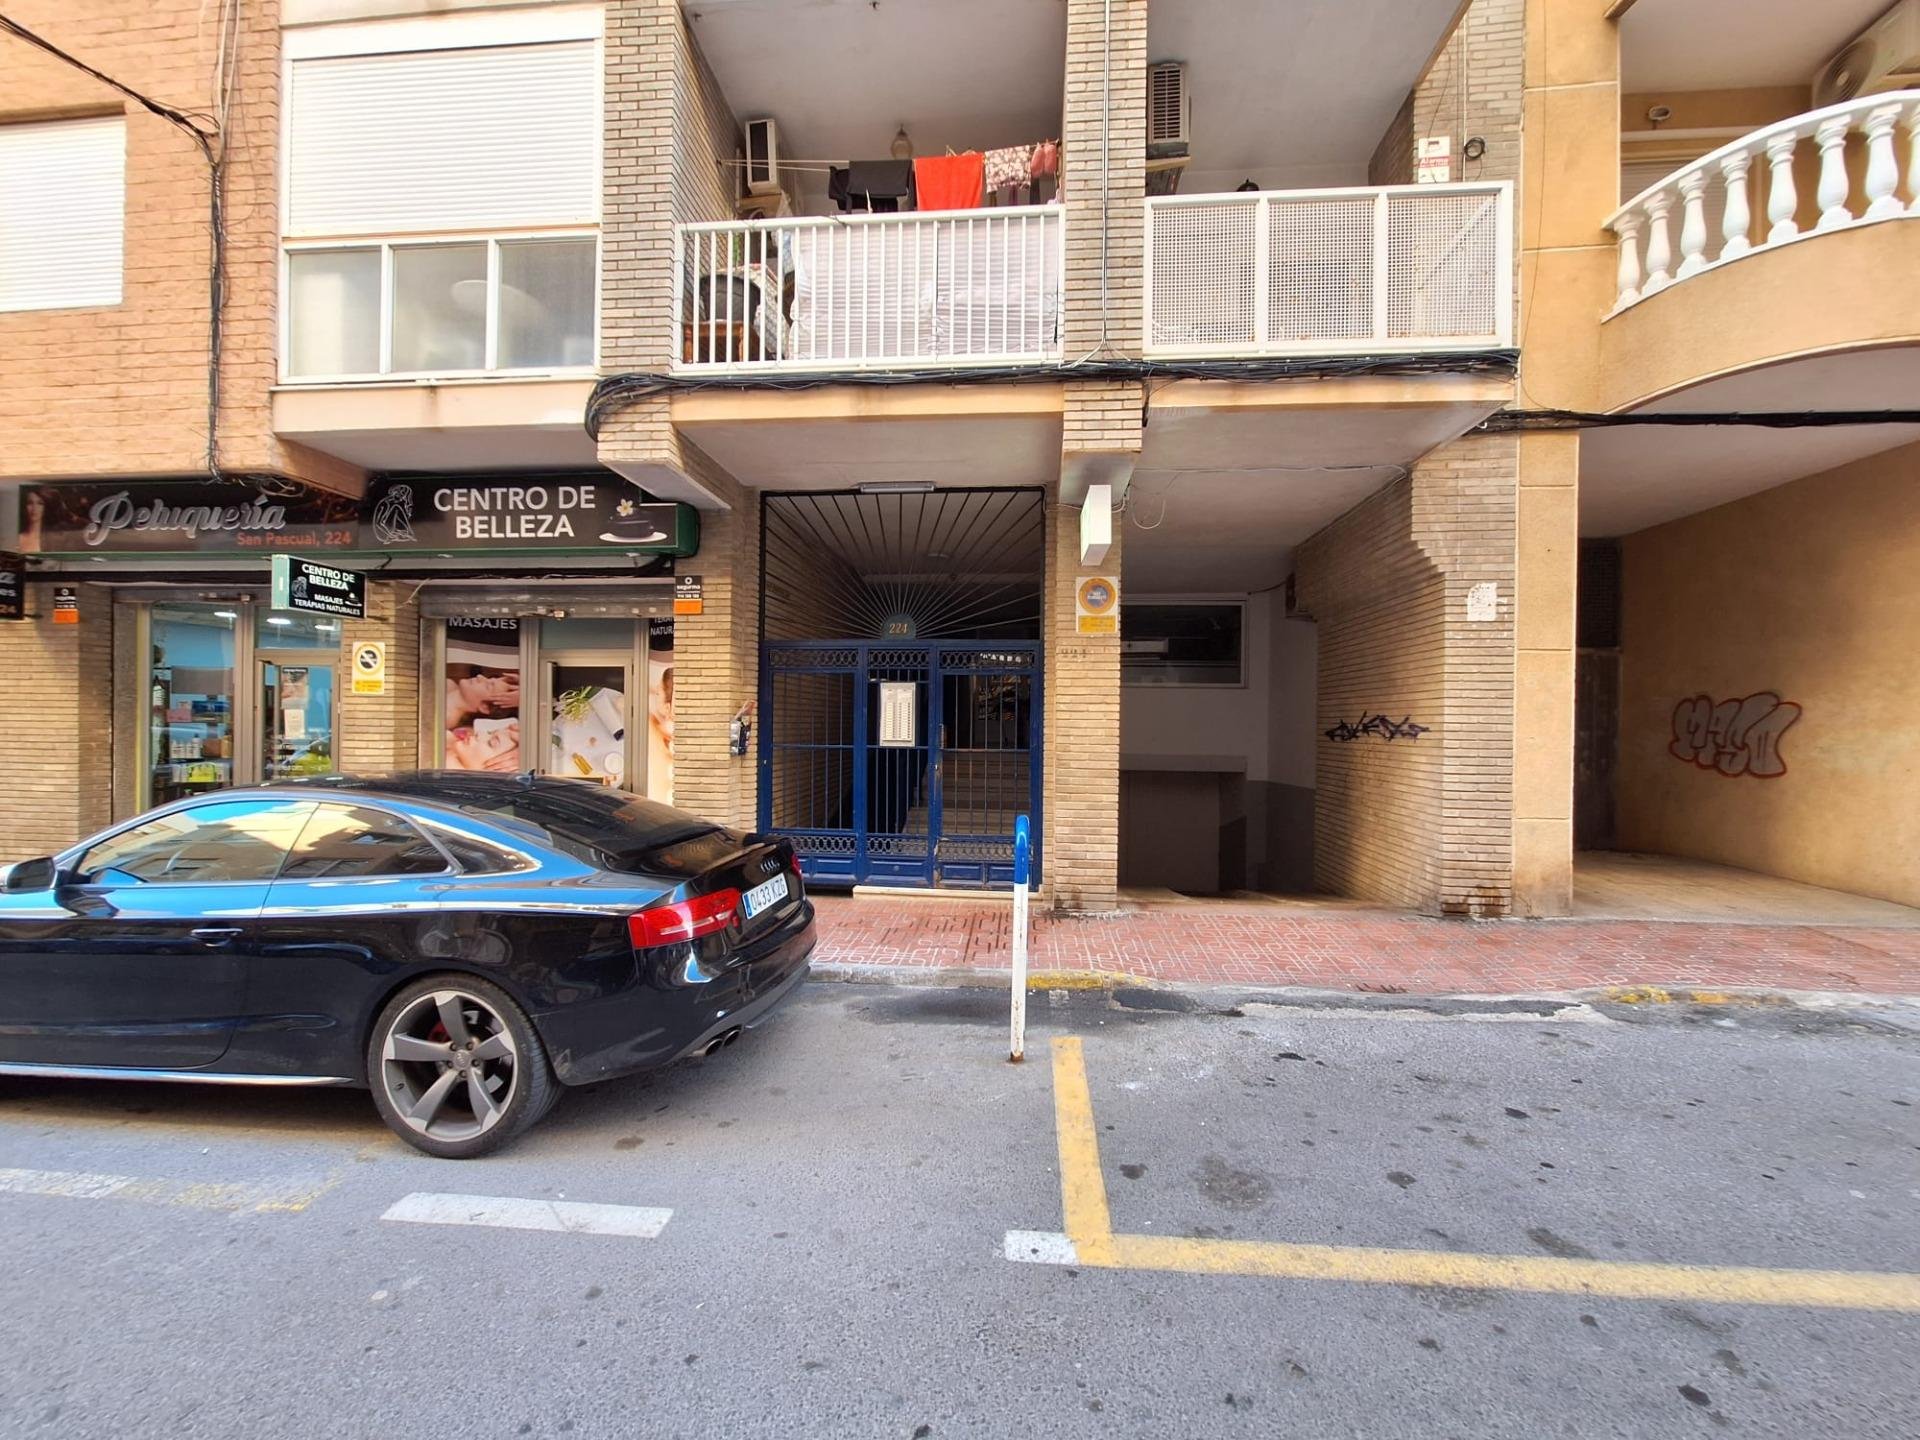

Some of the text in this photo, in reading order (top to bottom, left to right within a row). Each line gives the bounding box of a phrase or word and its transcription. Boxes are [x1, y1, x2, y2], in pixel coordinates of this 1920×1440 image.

[433, 485, 596, 512] CENTRO DE
[84, 490, 287, 546] Peluquería
[456, 514, 575, 539] BELLEZA
[236, 532, 351, 547] San Pascual, 224
[301, 563, 355, 583] CENTRO DE
[309, 574, 349, 591] BELLEZA
[314, 593, 343, 604] MASAJES
[326, 604, 360, 615] NATURALES
[448, 616, 518, 630] MASAJES
[650, 626, 675, 636] NATUR
[888, 623, 908, 634] 224
[750, 885, 772, 910] 0433
